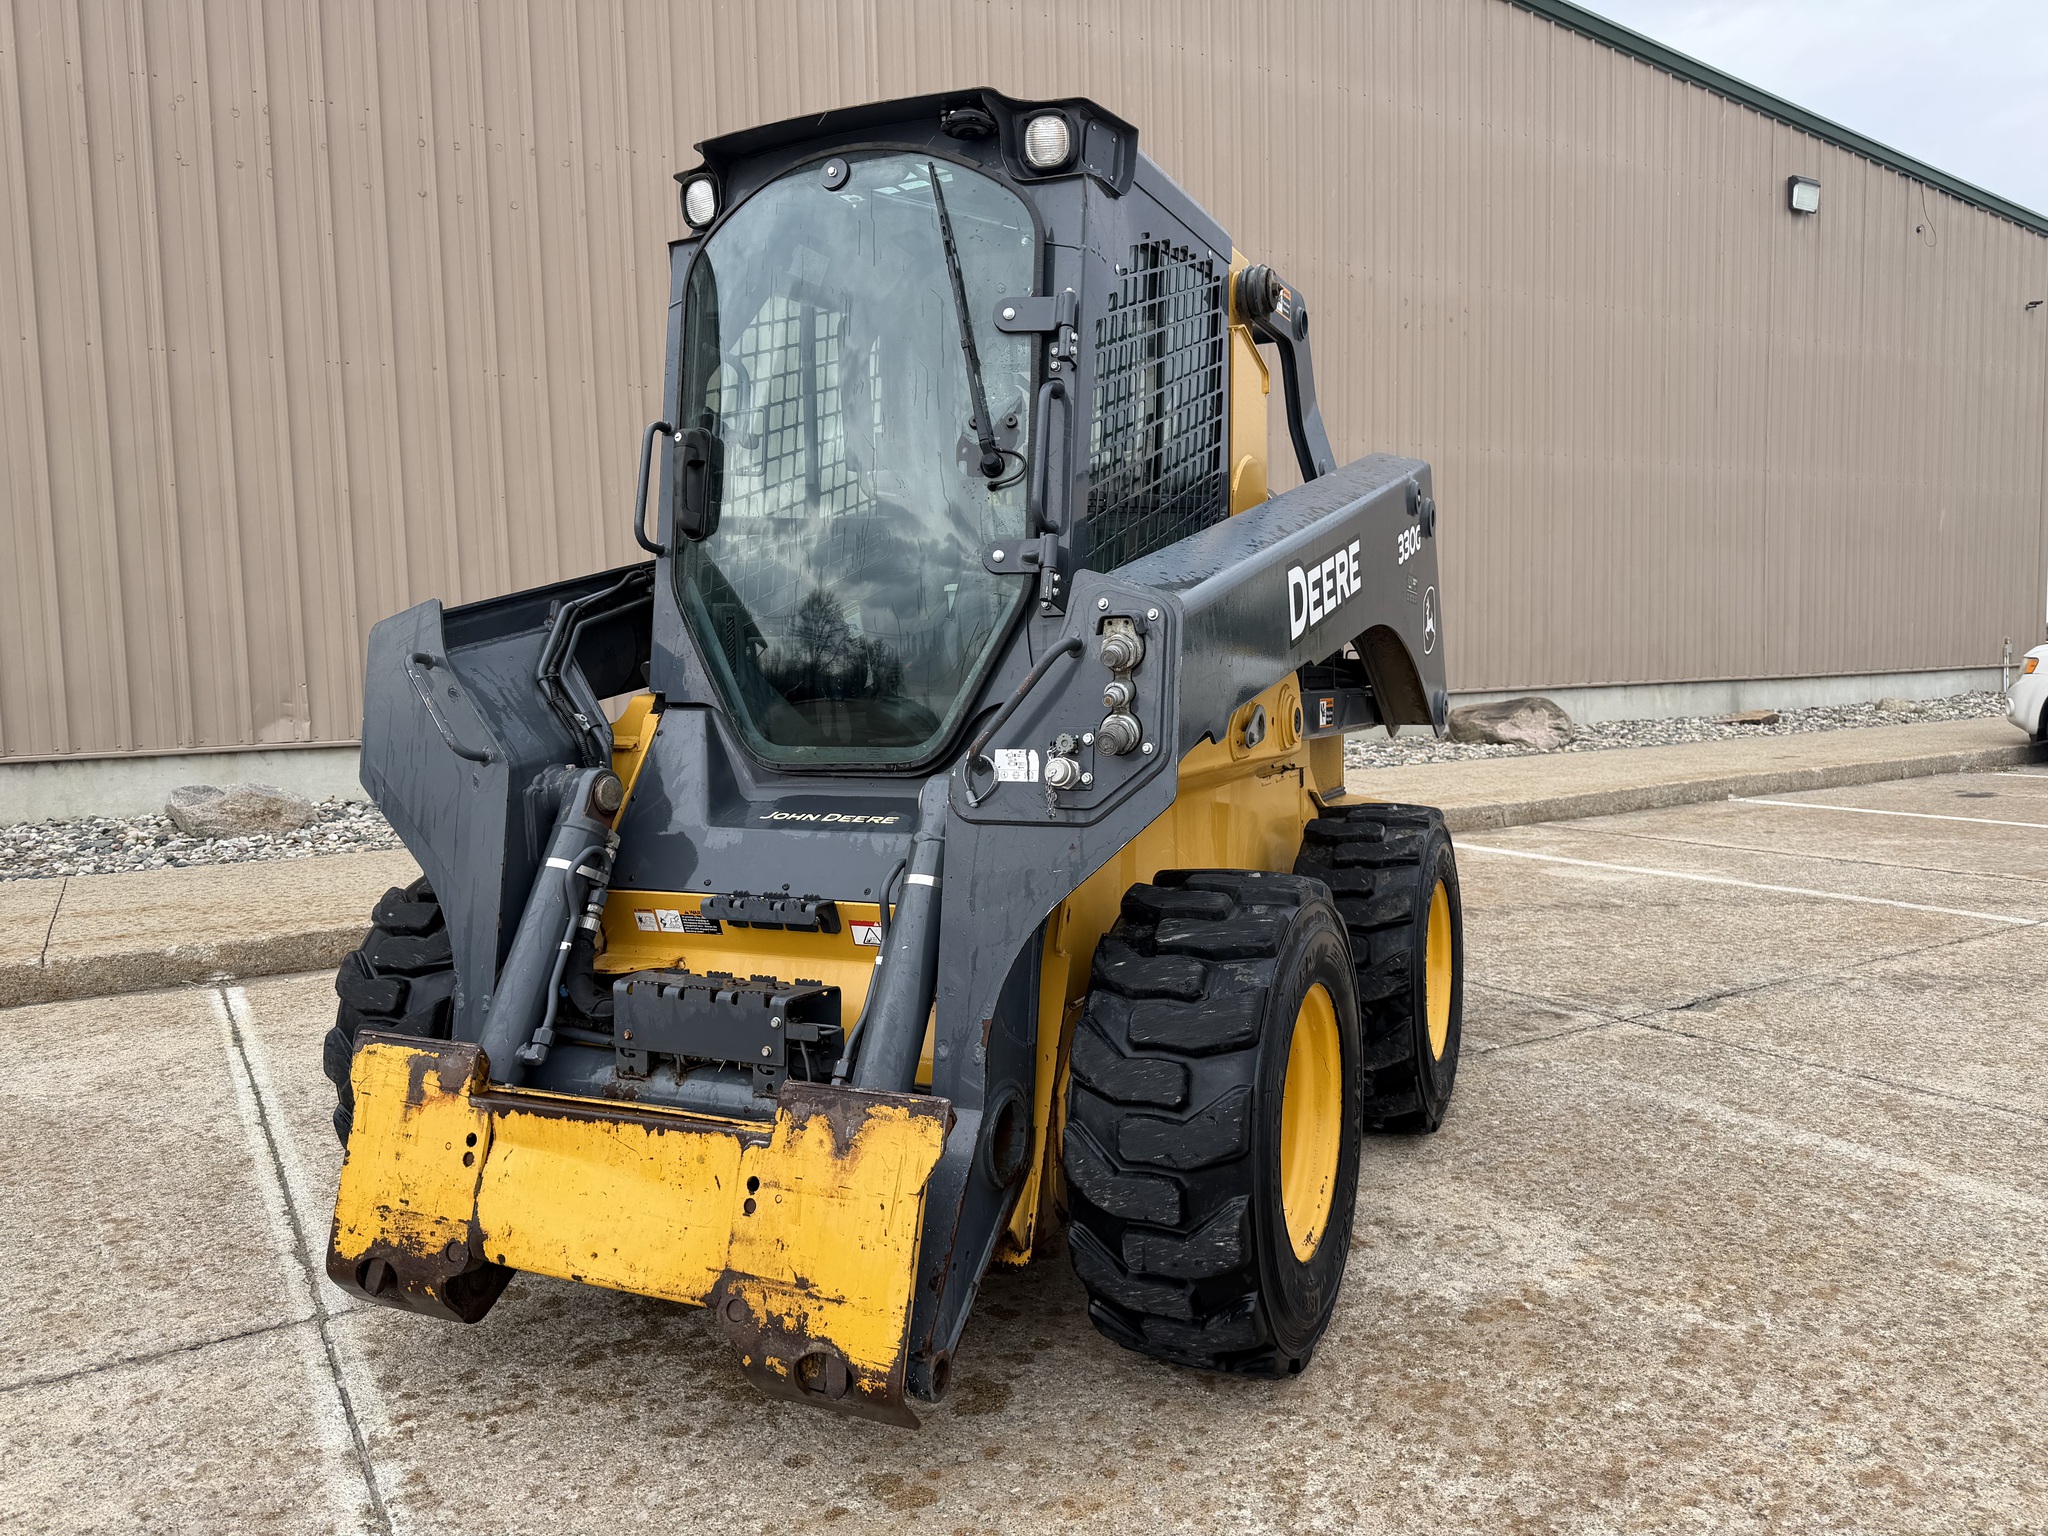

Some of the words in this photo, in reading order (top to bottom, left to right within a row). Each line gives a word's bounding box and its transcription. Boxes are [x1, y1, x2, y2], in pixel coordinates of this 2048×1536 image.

[1397, 524, 1421, 565] 330G
[1287, 539, 1361, 641] DEERE
[759, 811, 822, 821] JOHN
[821, 813, 900, 825] DEERE
